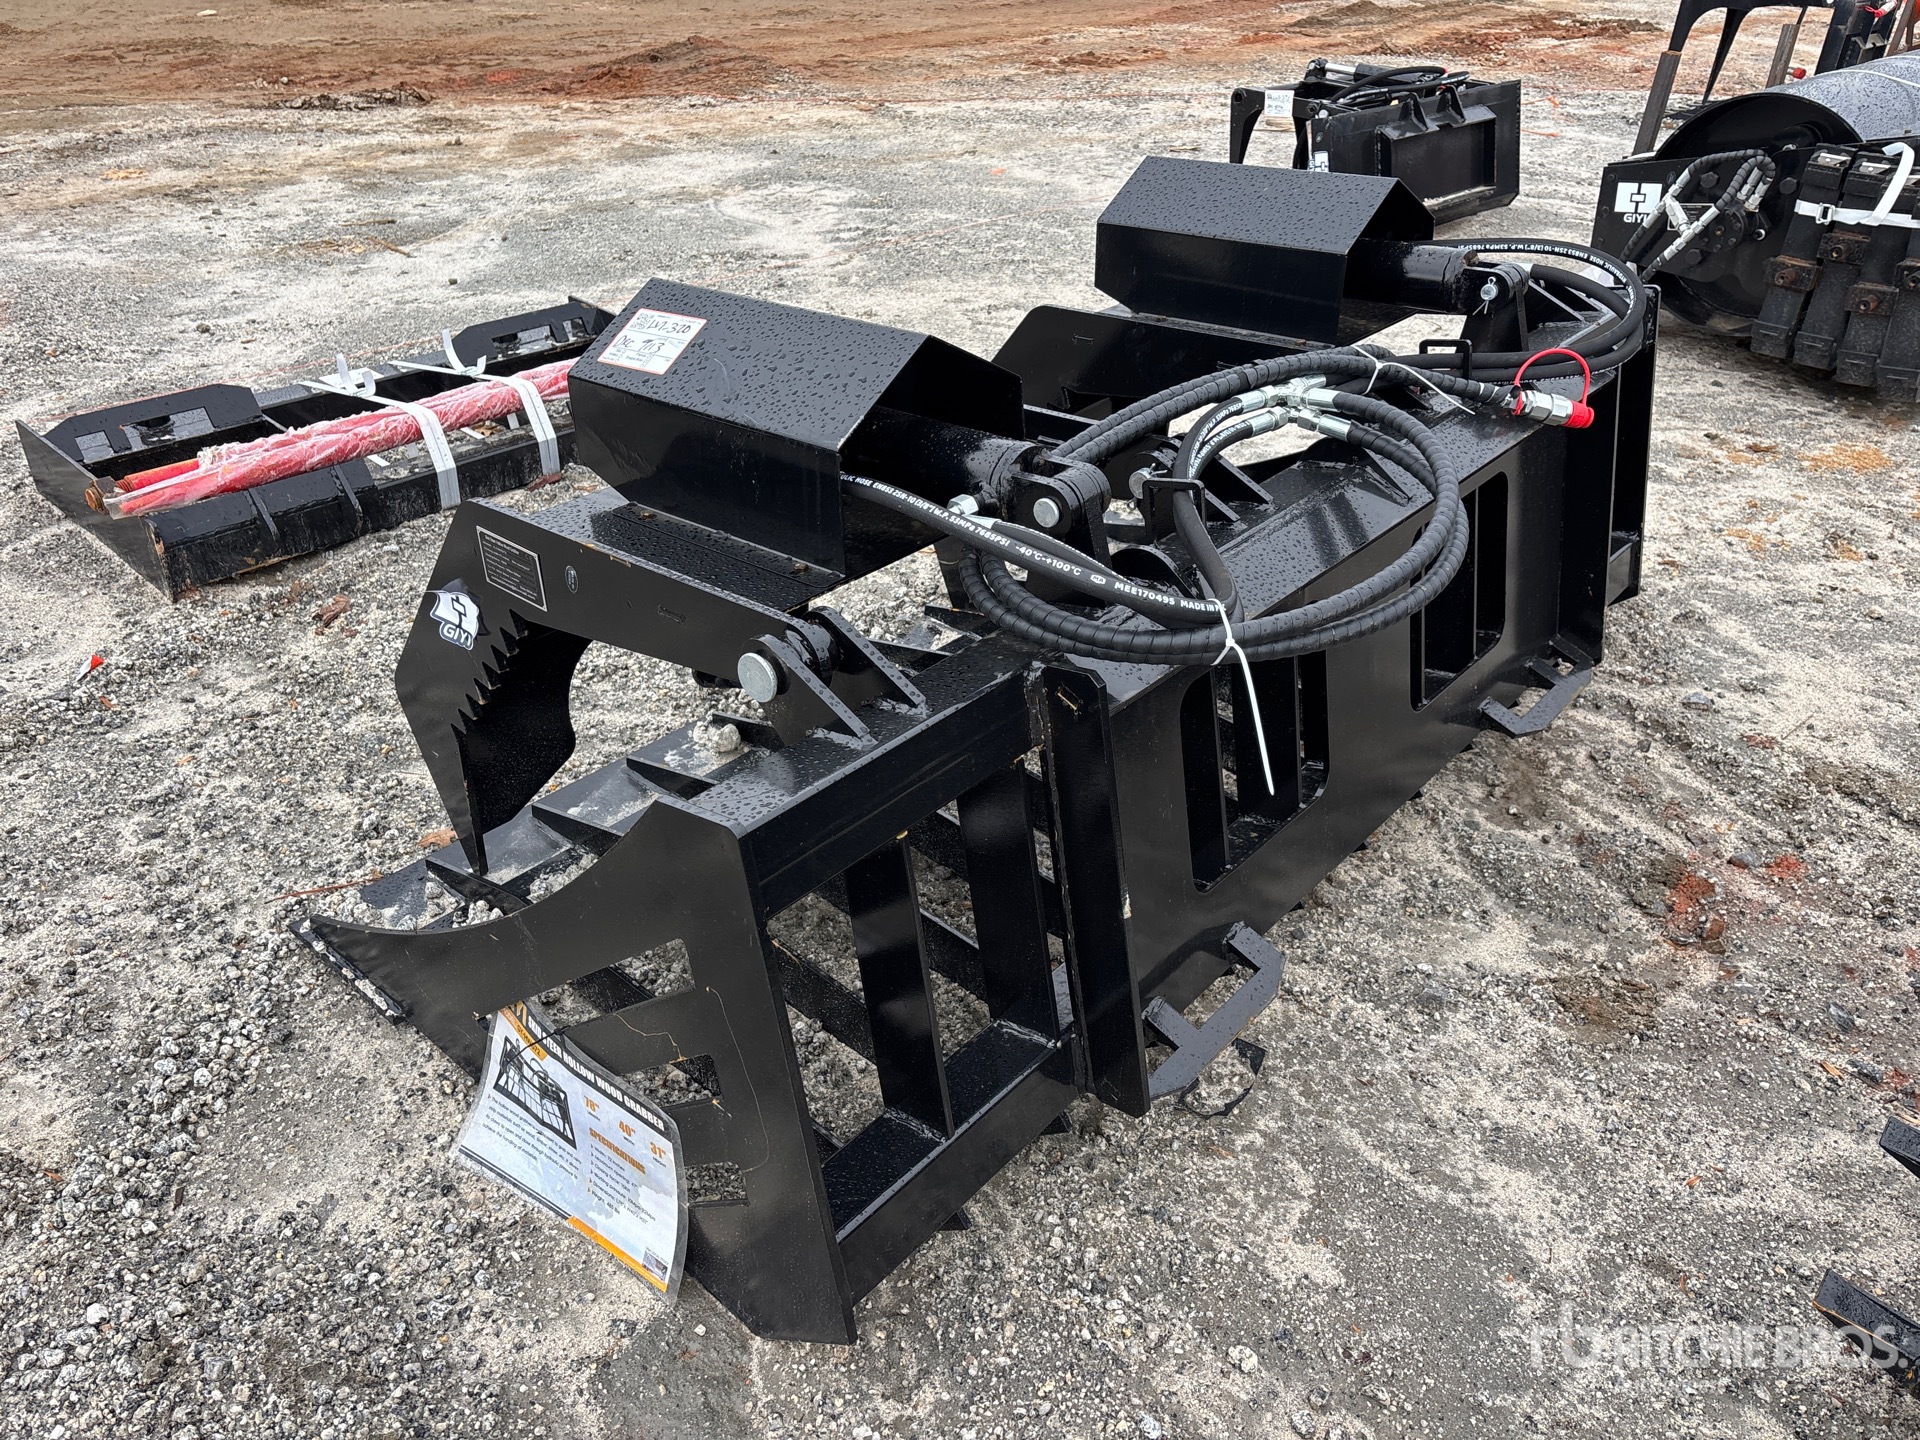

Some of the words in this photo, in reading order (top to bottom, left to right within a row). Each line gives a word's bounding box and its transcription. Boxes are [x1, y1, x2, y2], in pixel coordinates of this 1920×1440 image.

[1589, 255, 1604, 267] HOSE
[854, 476, 873, 487] HOSE
[949, 515, 976, 532] 53MPa
[1114, 581, 1176, 606] MEE170495
[1180, 599, 1206, 611] MADE
[443, 623, 471, 646] GIYI
[528, 1015, 542, 1040] SKID
[542, 1031, 563, 1059] STEER
[562, 1051, 595, 1083] HOLLOW
[595, 1075, 624, 1102] WOOD
[623, 1095, 665, 1132] GRABBER
[618, 1120, 636, 1137] 40"
[649, 1141, 666, 1160] 31"
